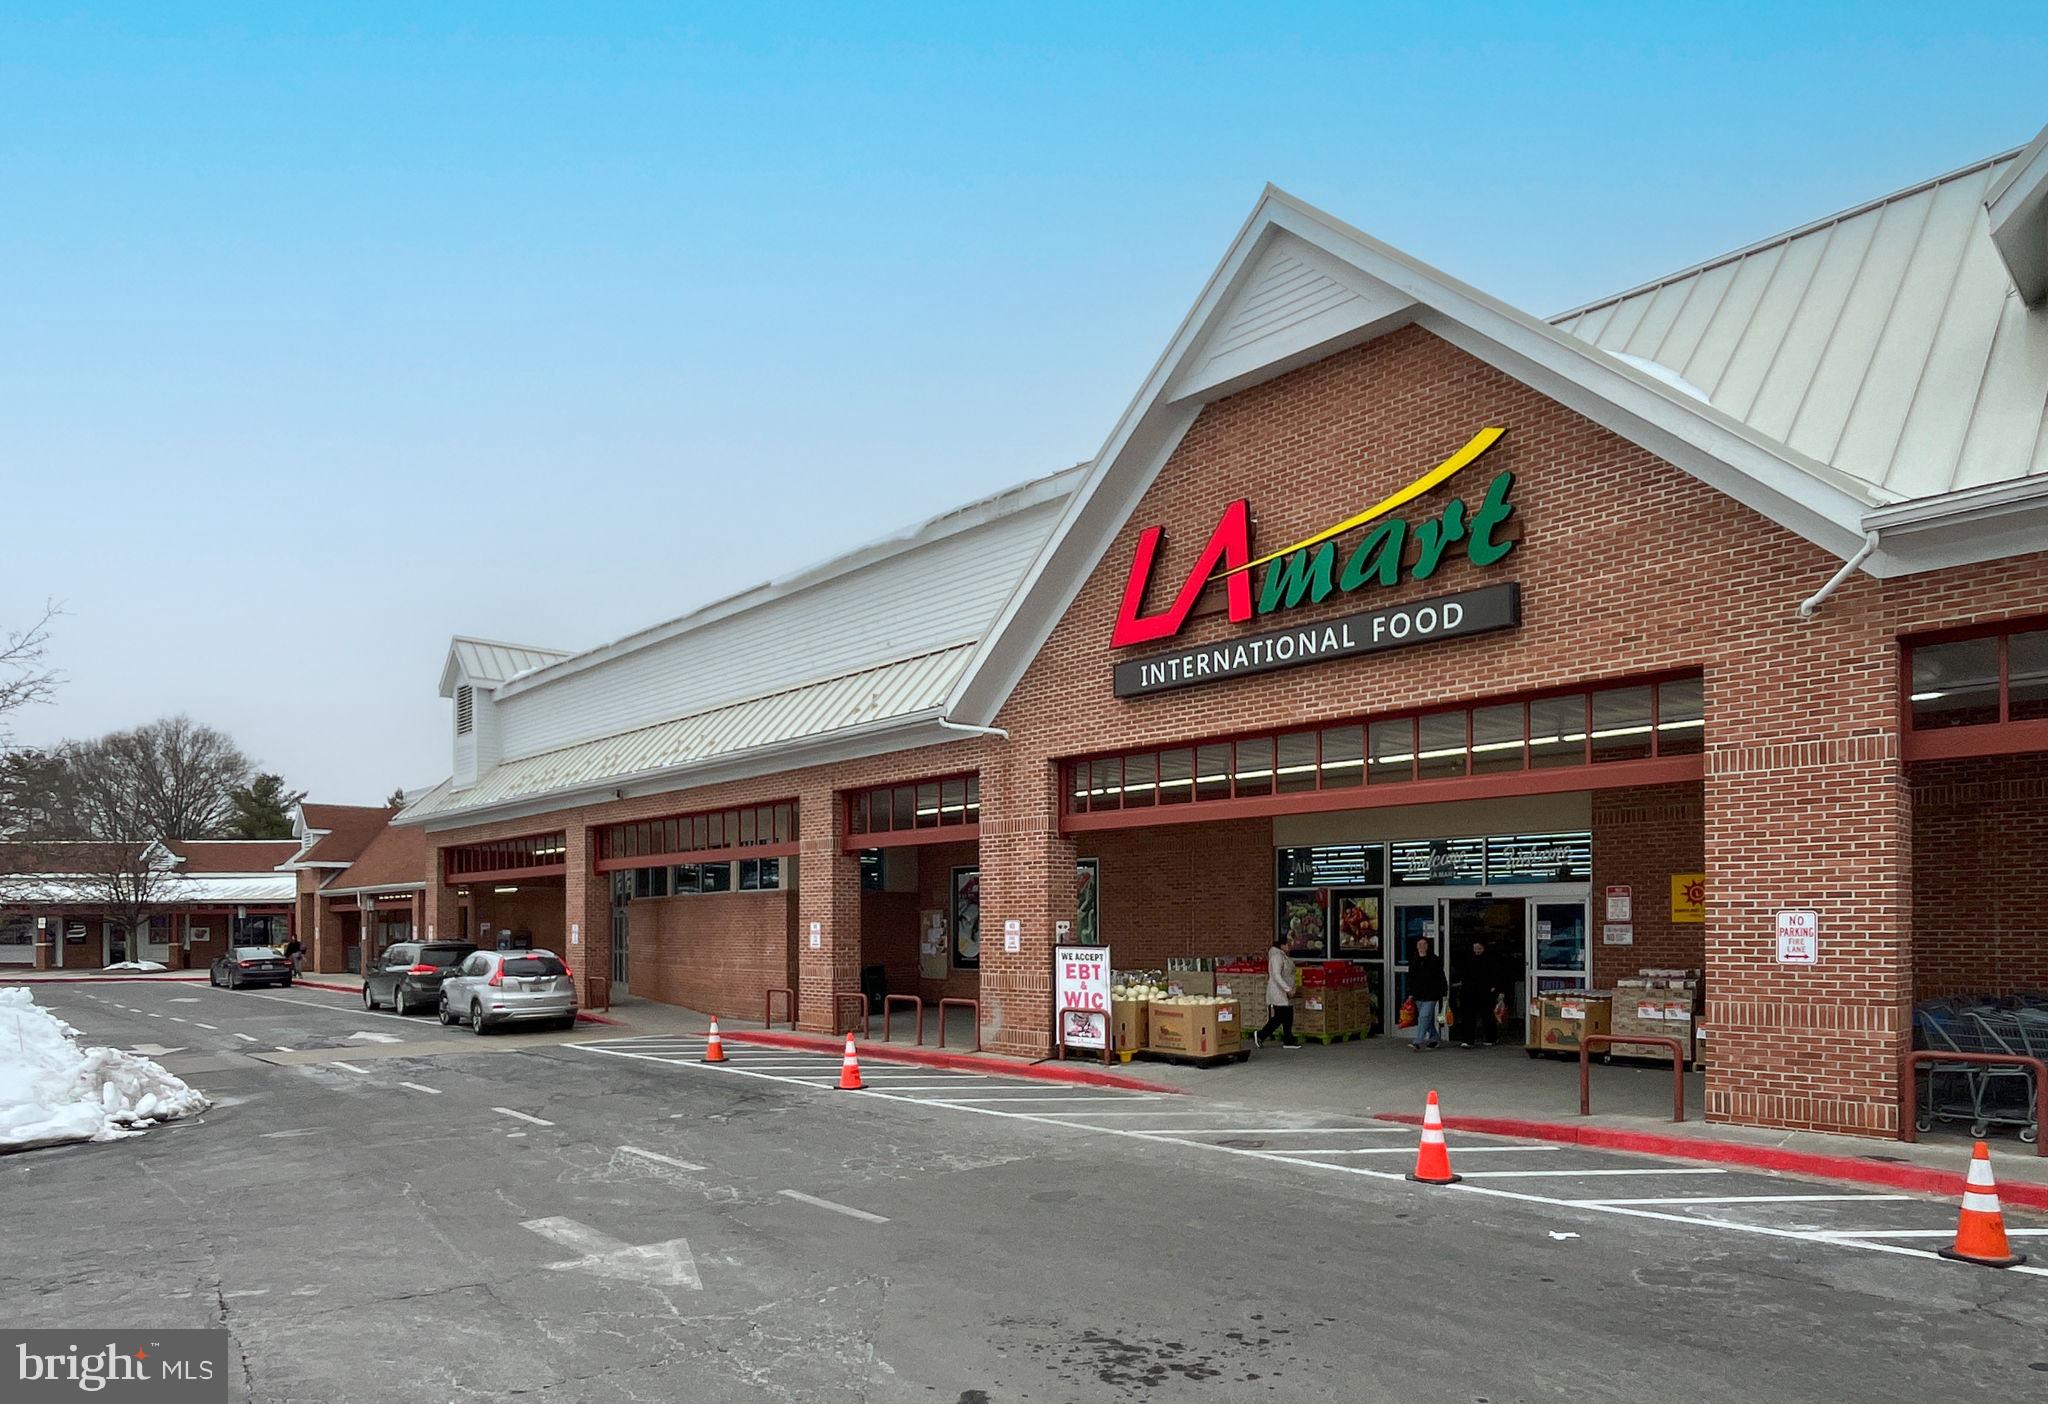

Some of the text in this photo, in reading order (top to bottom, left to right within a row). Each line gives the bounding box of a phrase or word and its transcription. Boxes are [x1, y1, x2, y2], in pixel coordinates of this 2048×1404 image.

[1140, 602, 1464, 687] INTERNATIONAL FOOD
[1789, 916, 1804, 926] NO
[1779, 927, 1814, 937] PARKING
[1075, 953, 1104, 961] ACCEPT
[1065, 963, 1101, 980] EBT
[1080, 980, 1087, 990] &
[1064, 990, 1104, 1009] WIC
